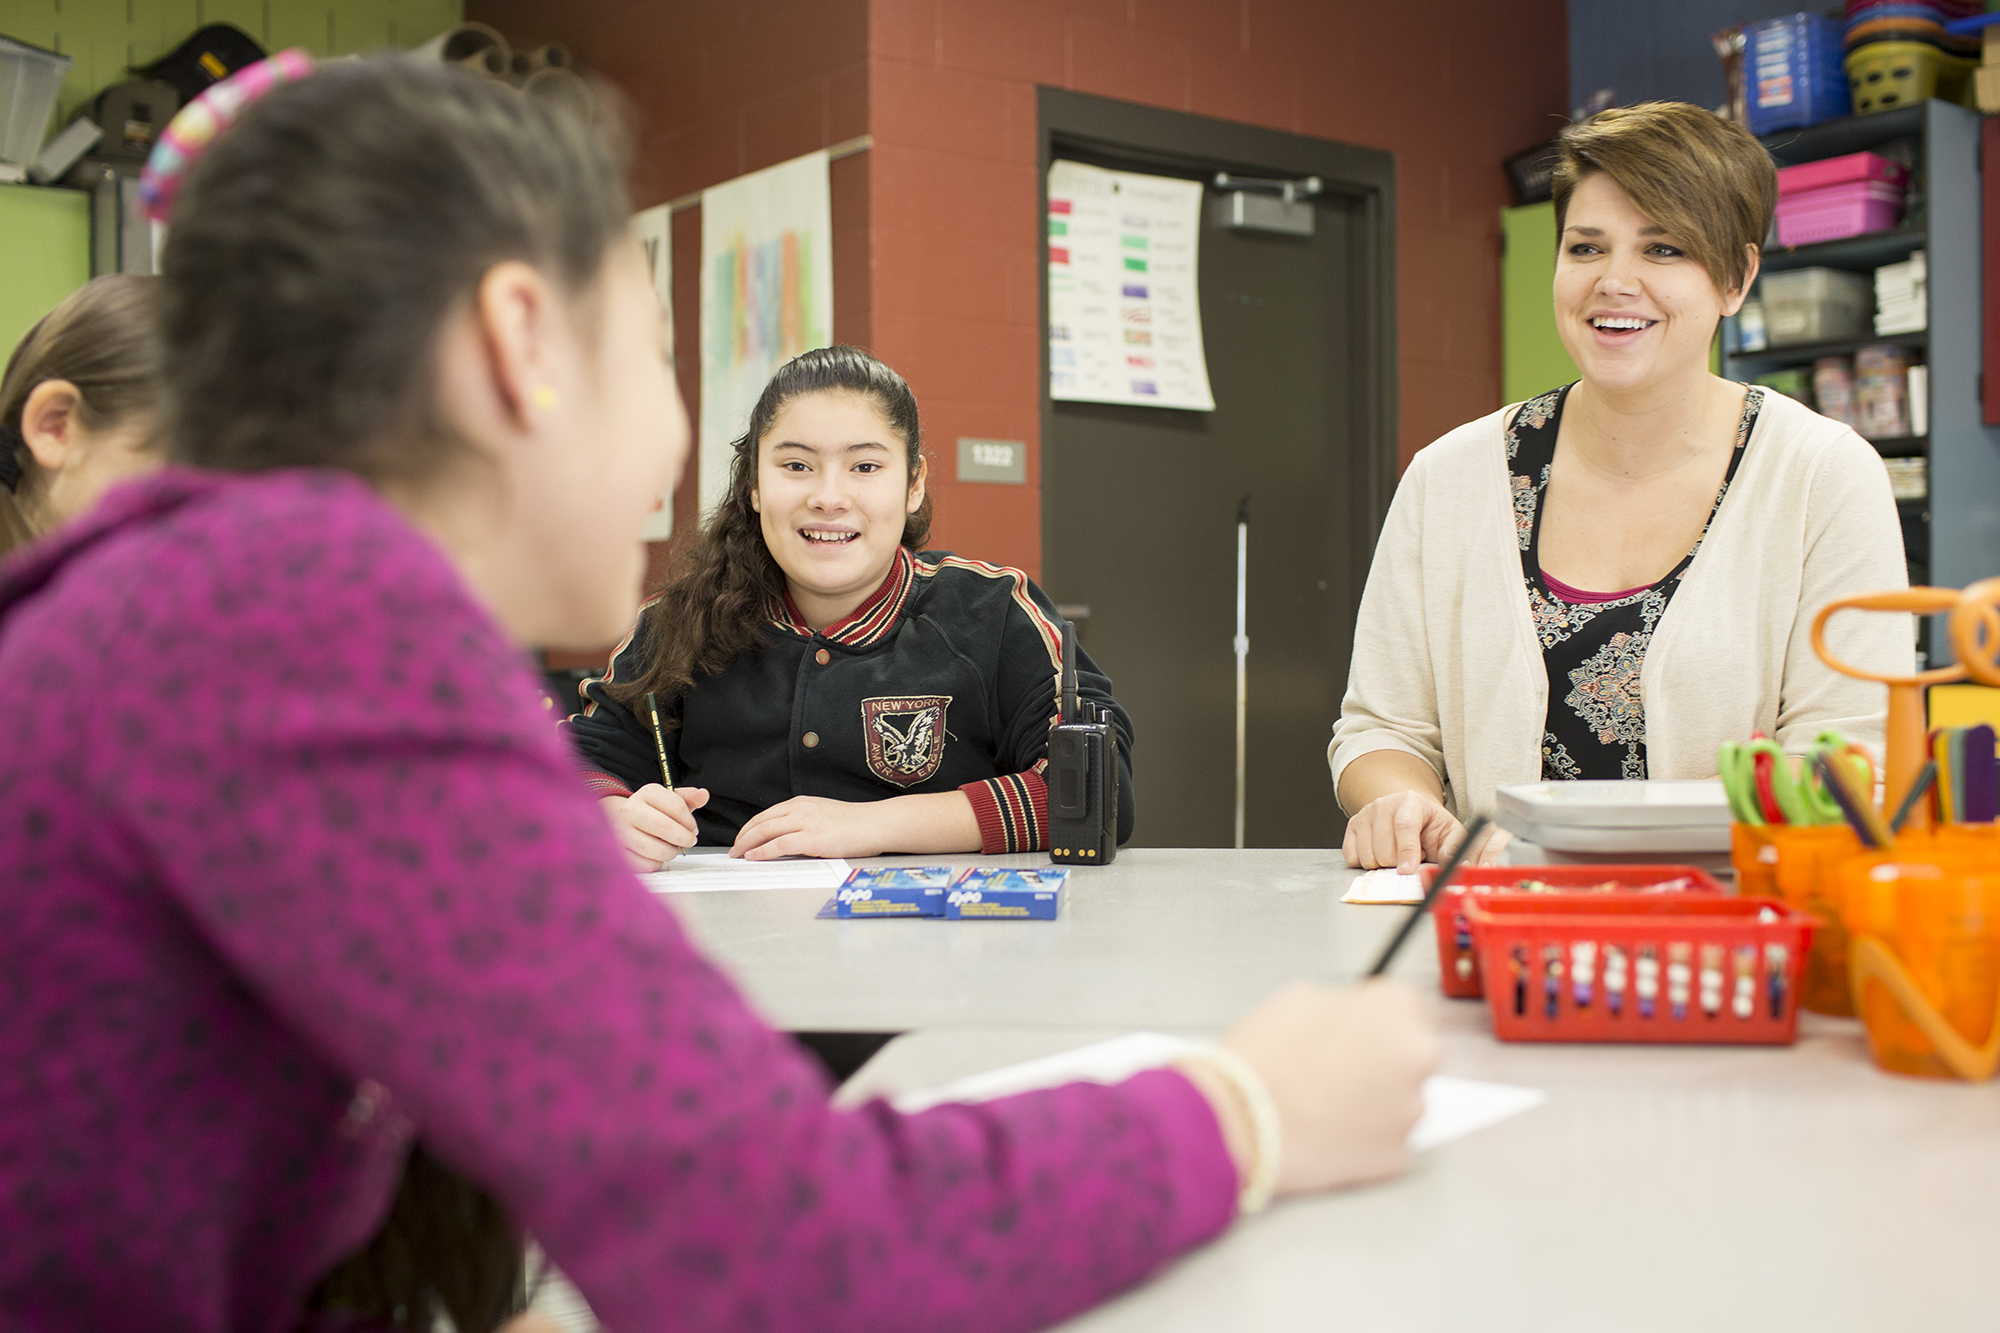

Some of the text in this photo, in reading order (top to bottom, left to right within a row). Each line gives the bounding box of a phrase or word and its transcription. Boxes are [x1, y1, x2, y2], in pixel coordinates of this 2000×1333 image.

[972, 443, 1014, 467] 1322
[872, 699, 940, 711] NEW YORK
[918, 736, 940, 777] EAGLE
[838, 888, 873, 905] EXPO
[947, 890, 983, 907] EXPO
